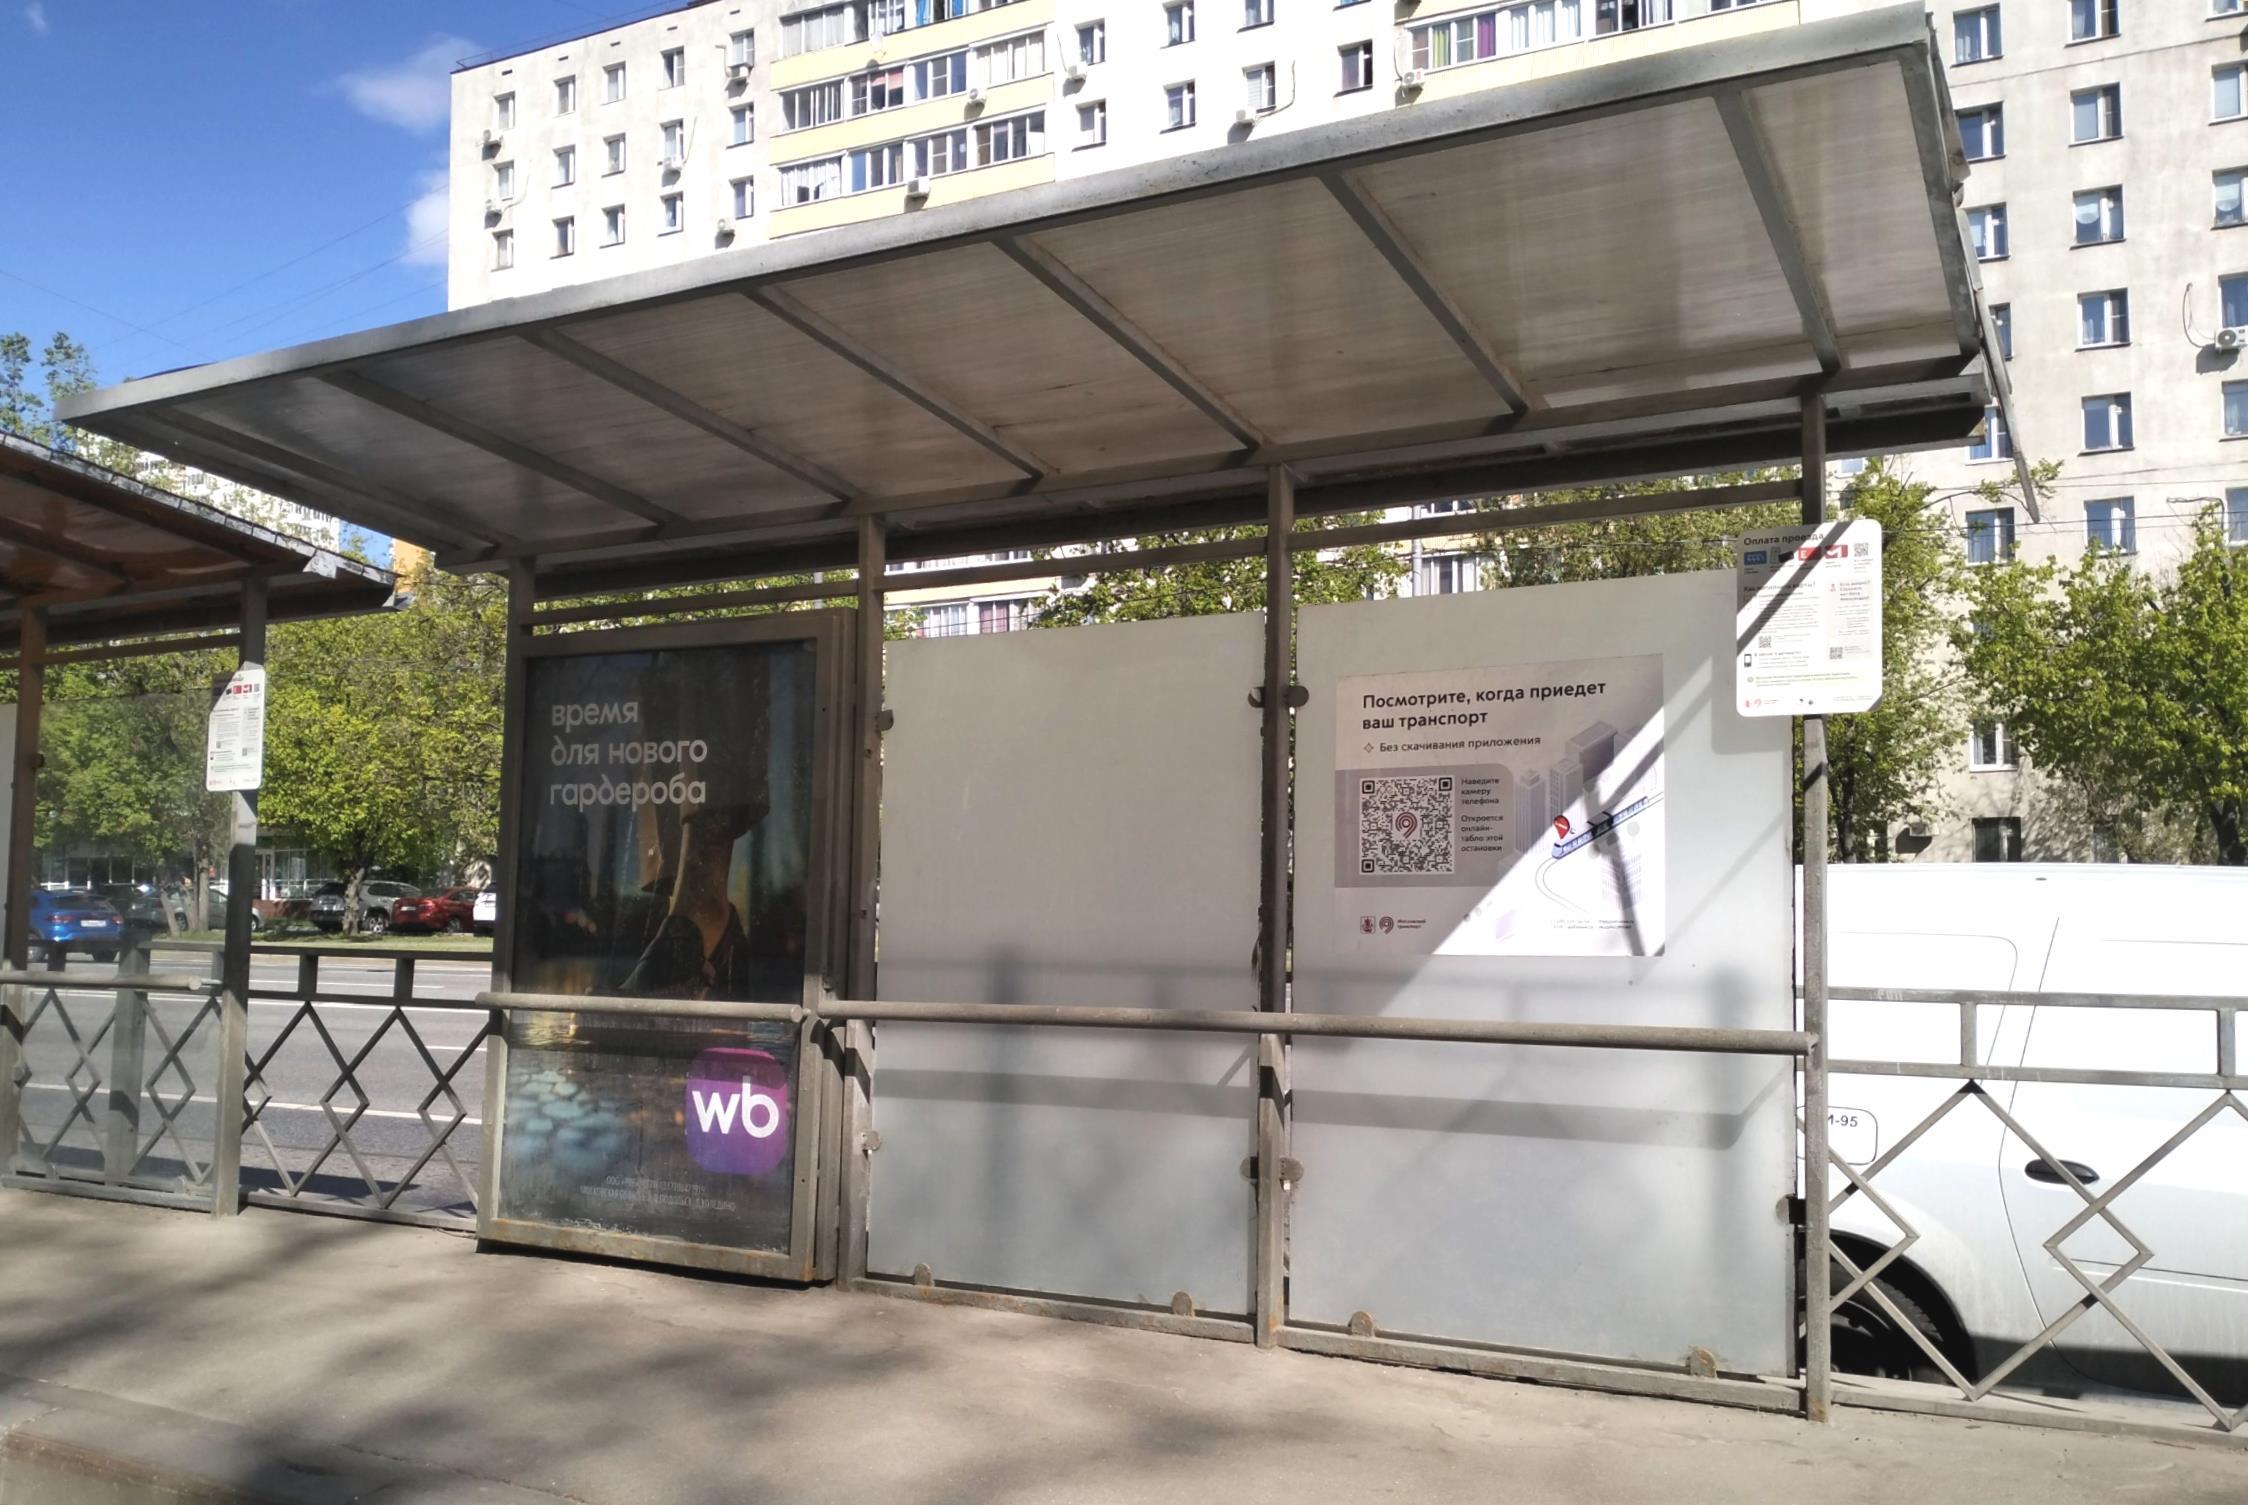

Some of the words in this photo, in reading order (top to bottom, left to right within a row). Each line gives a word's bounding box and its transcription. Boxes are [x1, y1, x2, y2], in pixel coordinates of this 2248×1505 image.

[1743, 536, 1780, 546] Оплата
[1363, 691, 1471, 709] Посмотрите,
[1476, 688, 1525, 702] когда
[1530, 682, 1606, 701] приедет
[551, 701, 639, 733] время
[1362, 718, 1395, 730] ваш
[1399, 712, 1489, 731] транспорт
[550, 735, 600, 766] для
[608, 739, 708, 765] нового
[1380, 742, 1399, 753] Без
[1401, 740, 1466, 752] скачивания
[1468, 737, 1542, 750] приложения
[550, 772, 706, 813] гардероба
[1461, 788, 1492, 796] камеру
[1460, 814, 1504, 824] Откроется
[691, 1075, 780, 1139] wb
